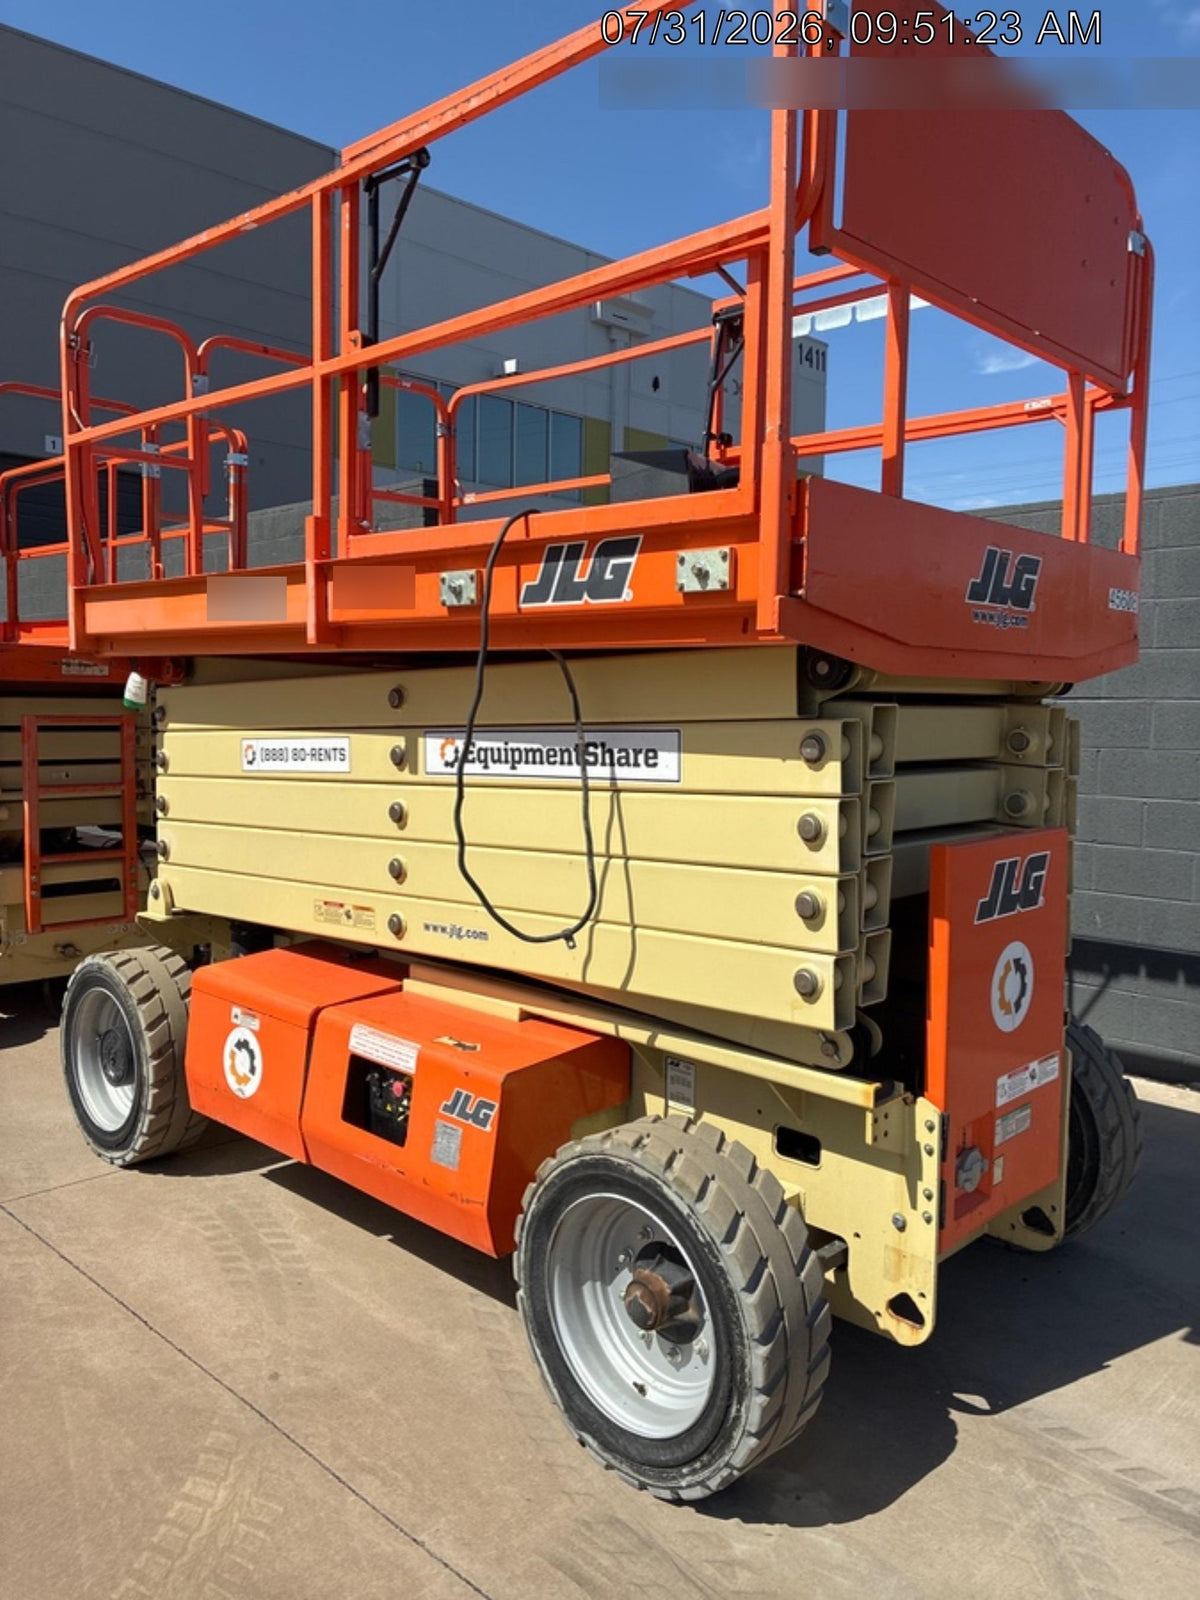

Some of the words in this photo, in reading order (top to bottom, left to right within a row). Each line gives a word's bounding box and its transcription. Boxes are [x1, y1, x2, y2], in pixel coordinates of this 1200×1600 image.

[798, 343, 826, 372] 1411
[519, 535, 643, 608] JLG
[965, 545, 1043, 611] JLG
[260, 747, 288, 762] (888)
[291, 747, 346, 762] 80-RENTS
[464, 741, 658, 770] EquipmentShare
[974, 851, 1051, 925] JLG
[423, 921, 489, 941] www.jlg.com
[439, 1087, 499, 1132] JLG
